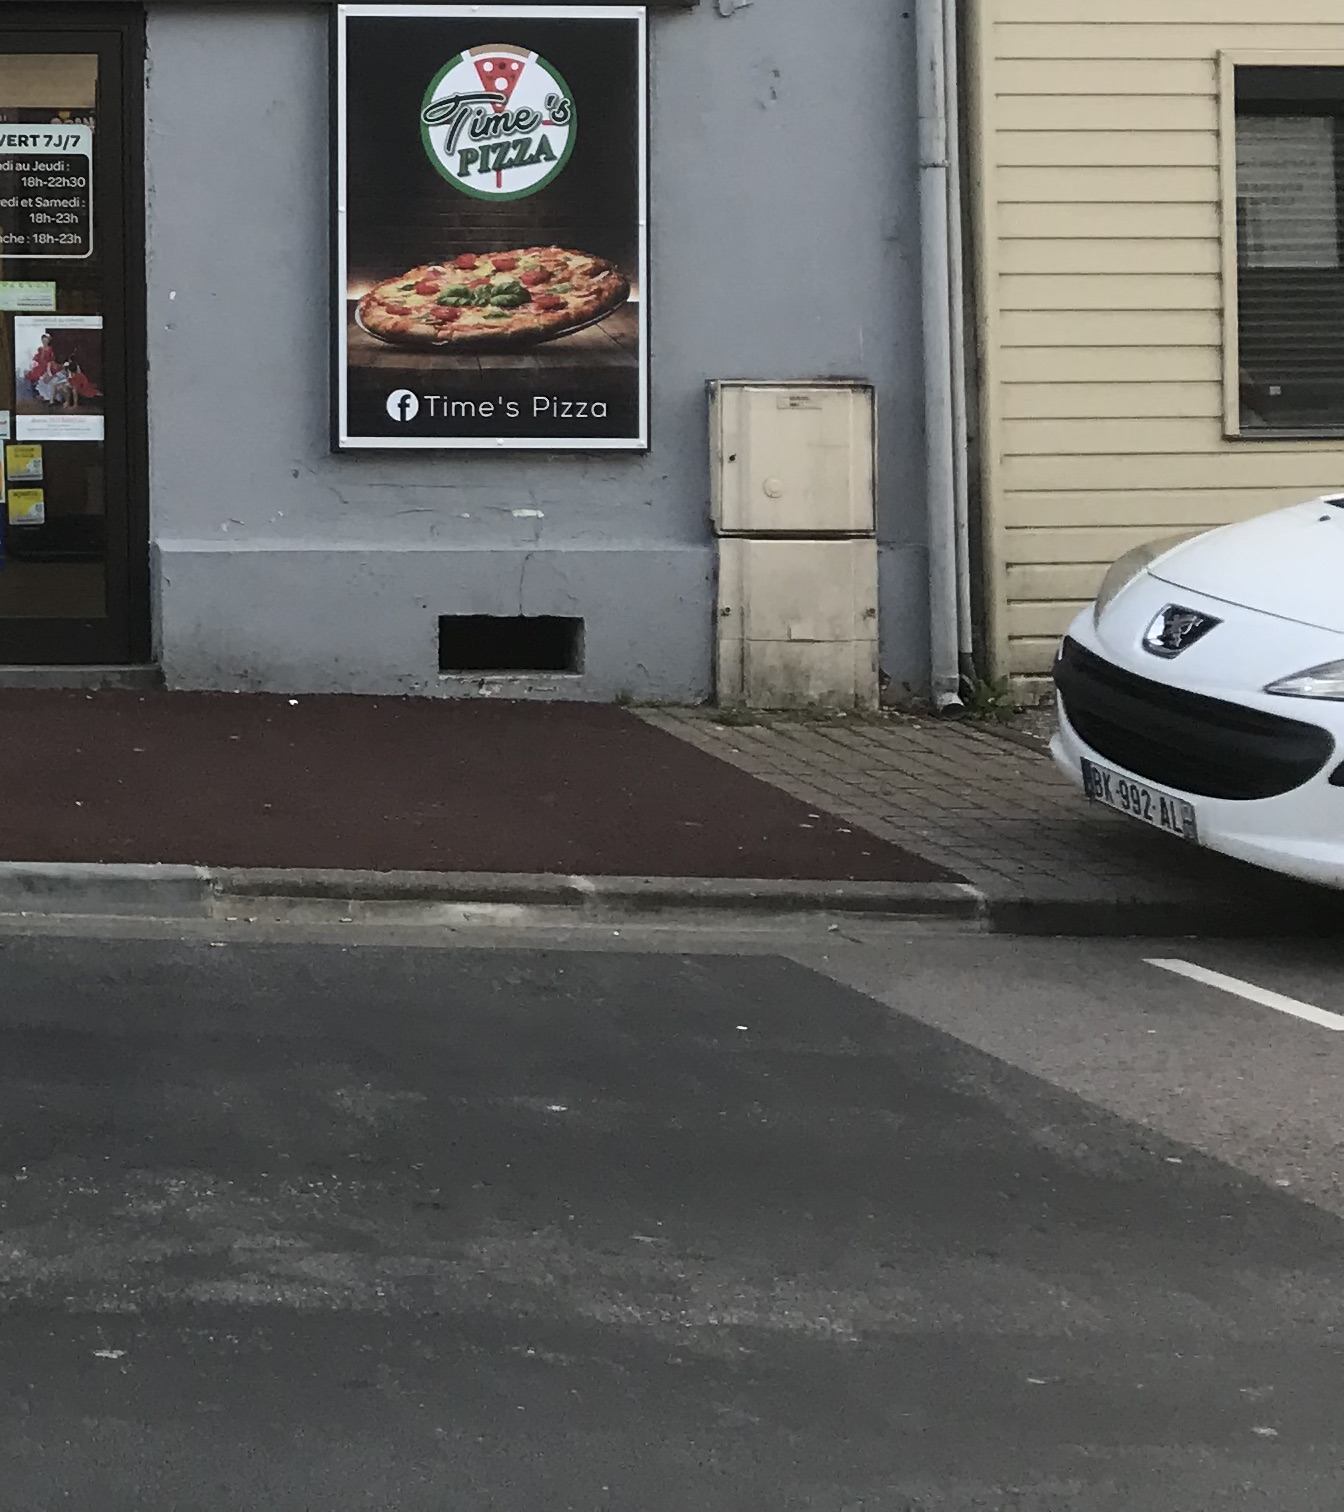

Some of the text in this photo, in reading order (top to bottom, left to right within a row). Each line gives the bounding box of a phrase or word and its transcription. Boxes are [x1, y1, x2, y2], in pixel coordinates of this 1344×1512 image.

[421, 91, 572, 153] Time's
[44, 134, 81, 150] 7J/7
[456, 134, 557, 177] PIZZA
[15, 163, 30, 171] au
[32, 161, 64, 171] Jeudi
[21, 177, 86, 188] 18h-22h30
[21, 197, 33, 207] et
[35, 196, 80, 207] Samedi
[29, 213, 79, 224] 18h-23h
[32, 233, 82, 244] 18h-23h
[424, 395, 520, 417] Time's
[533, 396, 607, 418] Pizza
